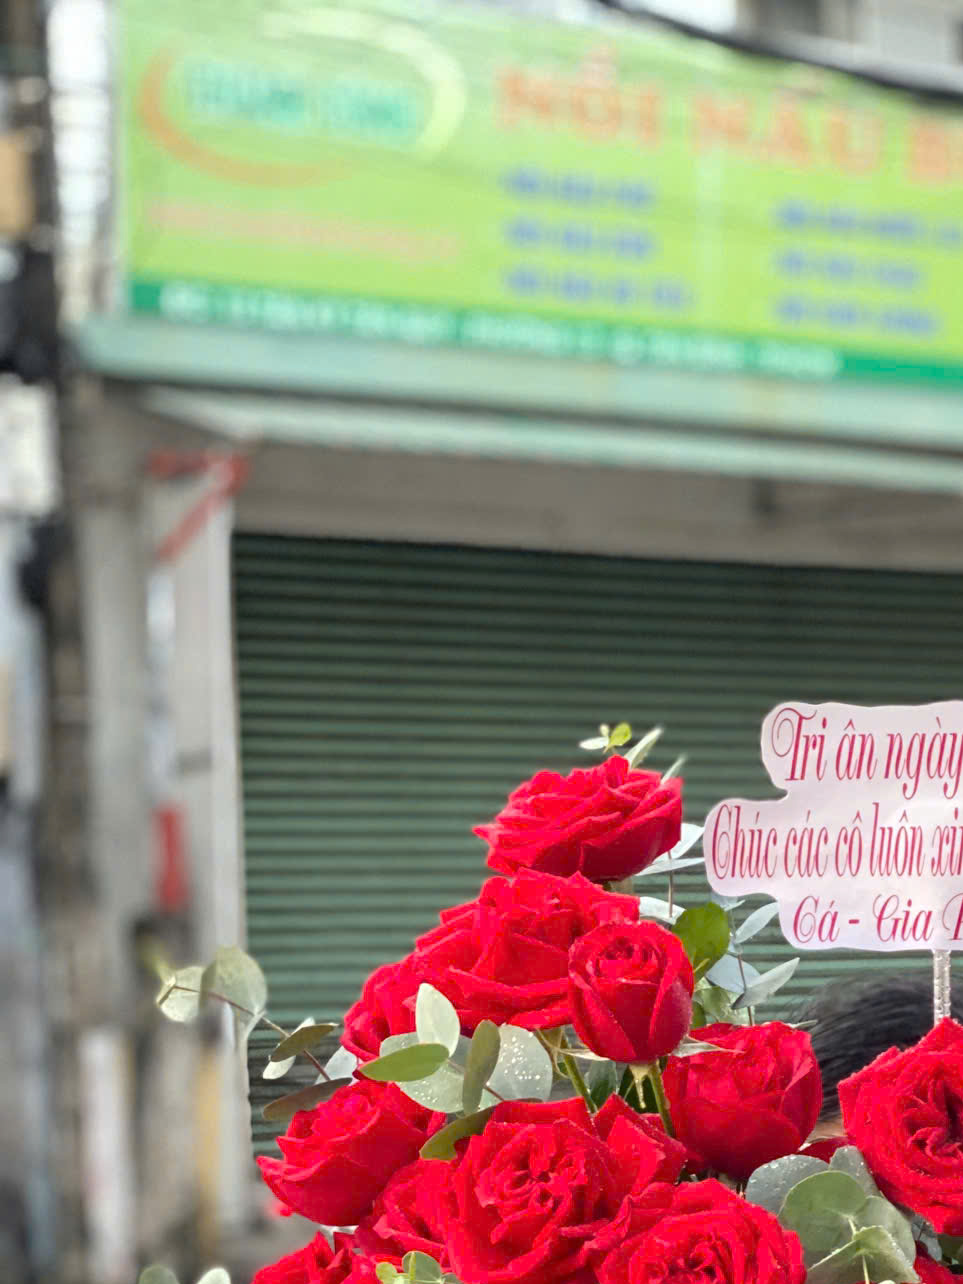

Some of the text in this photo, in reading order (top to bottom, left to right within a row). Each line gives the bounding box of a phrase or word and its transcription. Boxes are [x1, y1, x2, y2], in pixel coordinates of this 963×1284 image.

[771, 707, 828, 782] Tri
[835, 718, 878, 781] ân
[711, 803, 778, 880] Chúc
[783, 809, 829, 879] các
[834, 809, 863, 878] cô
[869, 801, 925, 878] luôn
[872, 893, 936, 943] Gia
